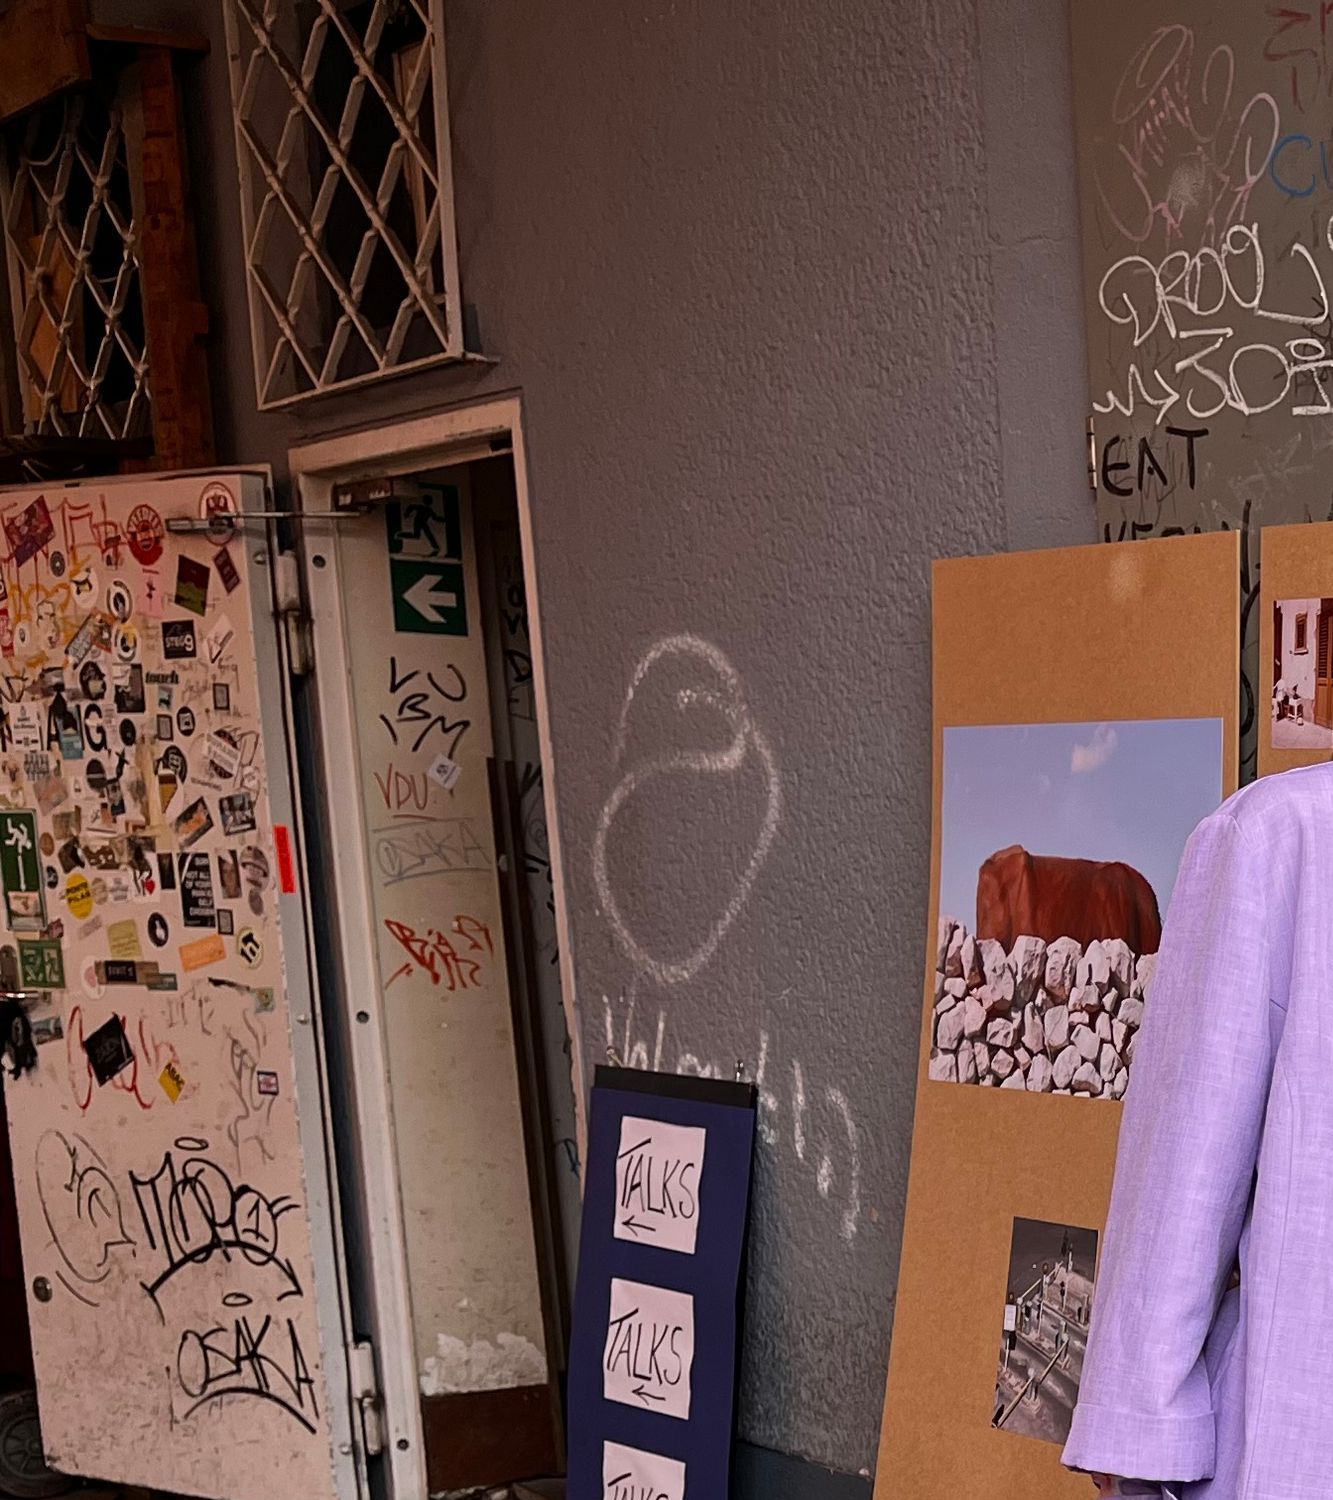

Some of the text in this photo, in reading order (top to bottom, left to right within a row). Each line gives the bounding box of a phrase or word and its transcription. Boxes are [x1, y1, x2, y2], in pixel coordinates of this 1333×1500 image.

[1102, 426, 1209, 496] EAT
[618, 1138, 696, 1220] TALKS
[606, 1308, 684, 1387] TALKS
